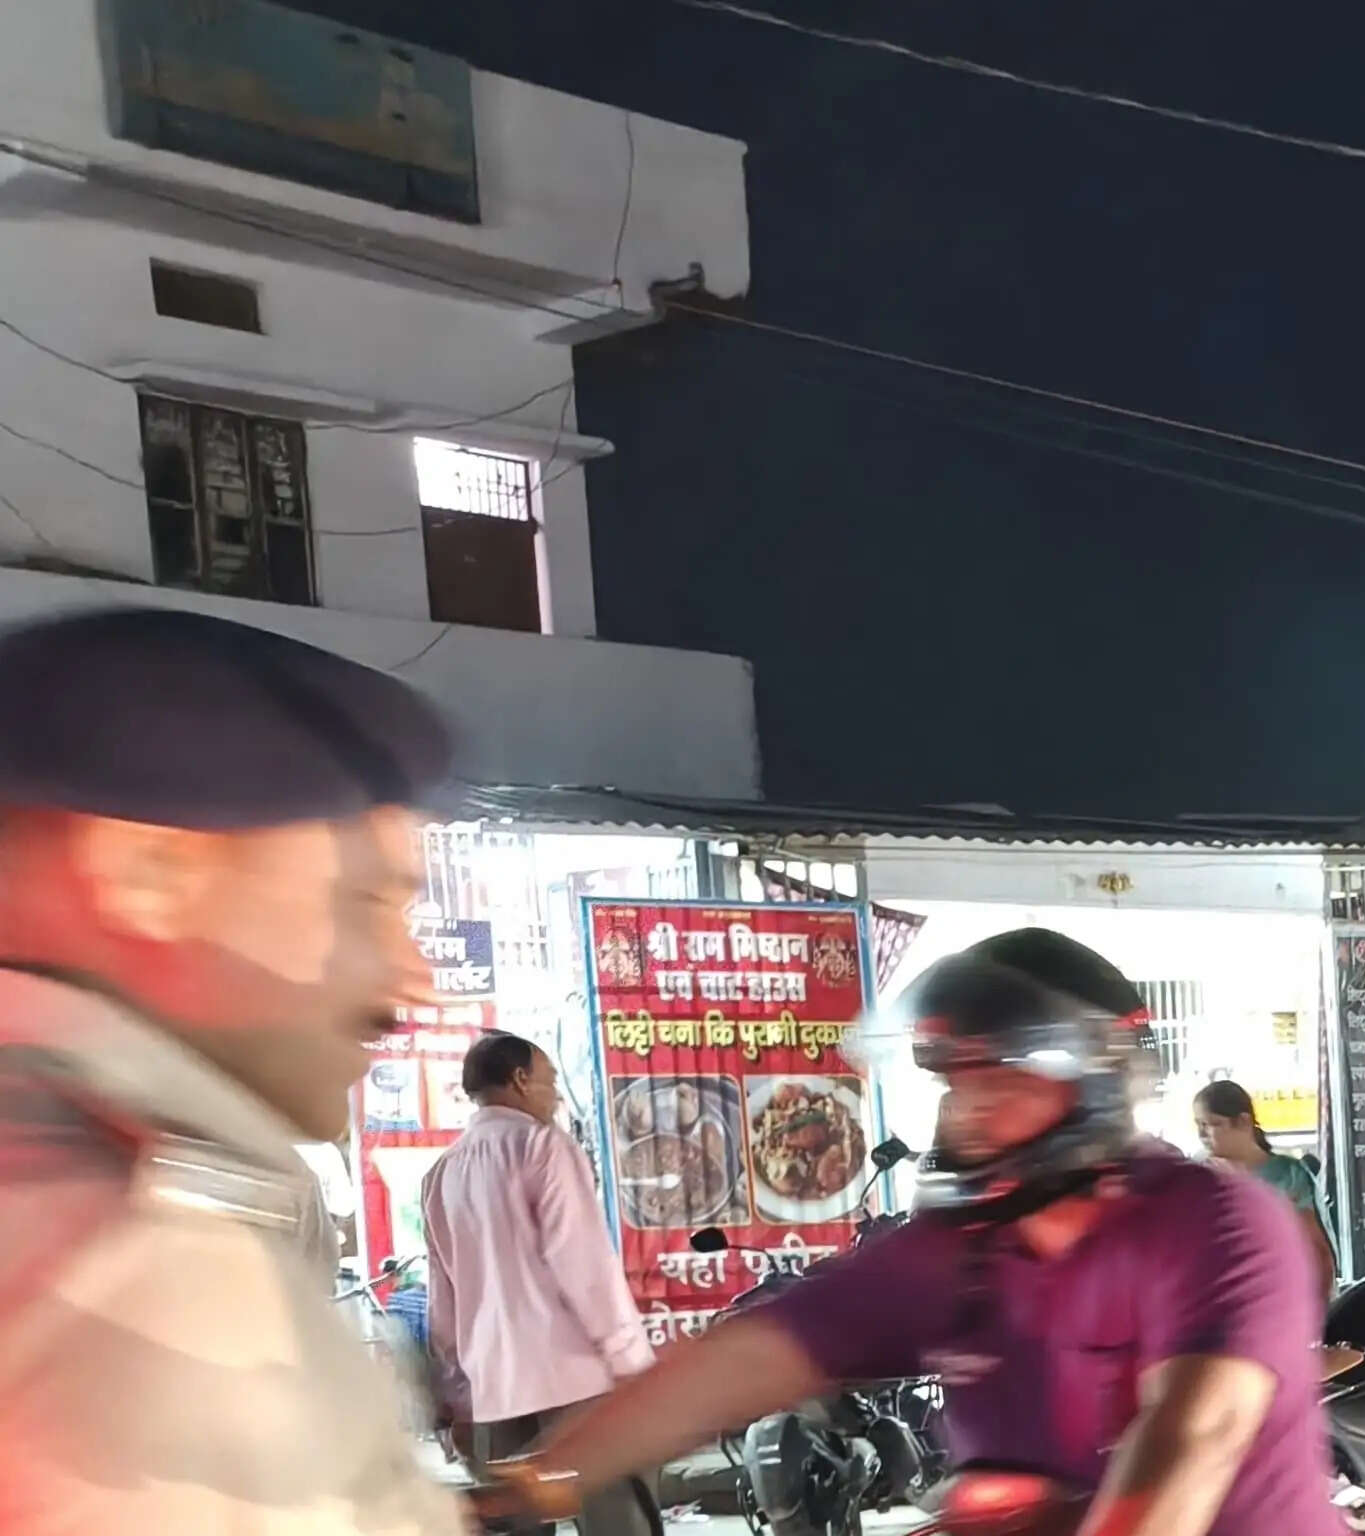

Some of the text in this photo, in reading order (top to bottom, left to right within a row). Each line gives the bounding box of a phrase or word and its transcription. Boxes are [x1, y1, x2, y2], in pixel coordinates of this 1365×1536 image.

[648, 922, 678, 961] श्री
[682, 931, 725, 961] राम
[698, 971, 743, 1001] चाट
[657, 1020, 701, 1046] चना
[704, 1008, 735, 1046] कि
[739, 1010, 797, 1060] पुरानी
